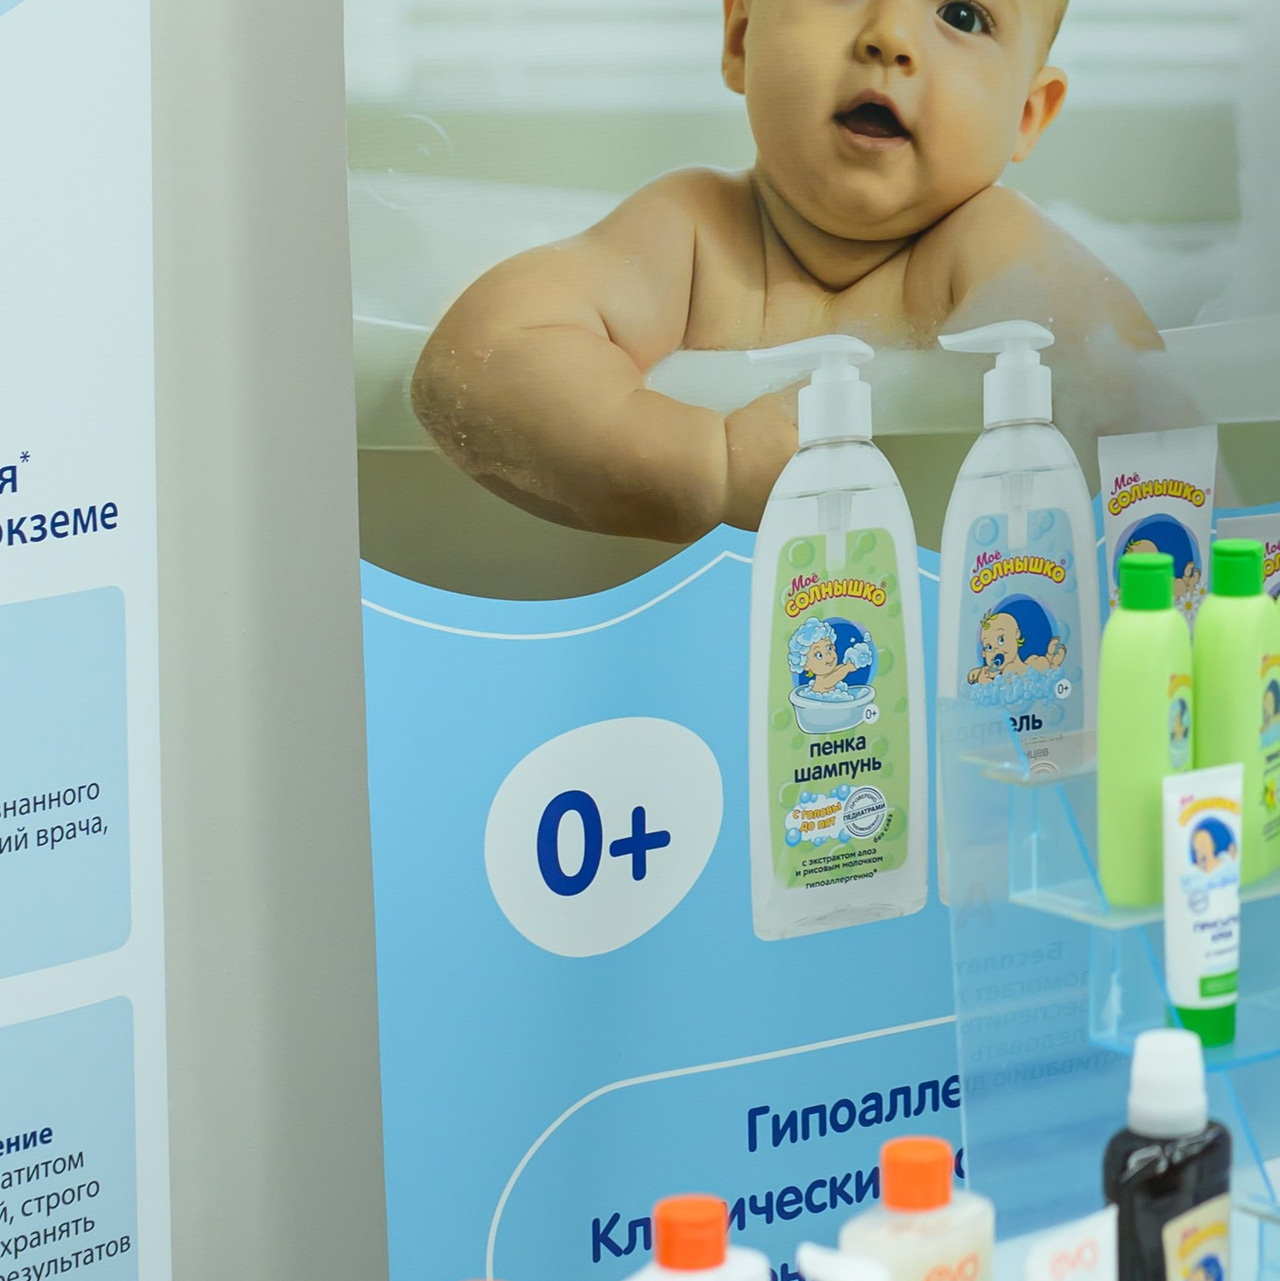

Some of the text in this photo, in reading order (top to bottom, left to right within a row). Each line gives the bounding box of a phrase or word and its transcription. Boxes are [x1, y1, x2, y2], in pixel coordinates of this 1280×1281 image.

[1110, 472, 1141, 495] Моё
[0, 502, 118, 547] кземе
[972, 549, 1002, 573] Моё
[788, 572, 820, 597] Моё
[810, 735, 866, 758] пенка
[794, 756, 883, 784] шампунь
[0, 782, 100, 819] нанного
[843, 803, 886, 822] ПЕДИАТРАМИ
[36, 815, 108, 850] врача,
[536, 789, 672, 897] 0+
[803, 863, 841, 878] рисовым
[809, 852, 856, 867] экстрактом
[21, 1180, 100, 1217] строго
